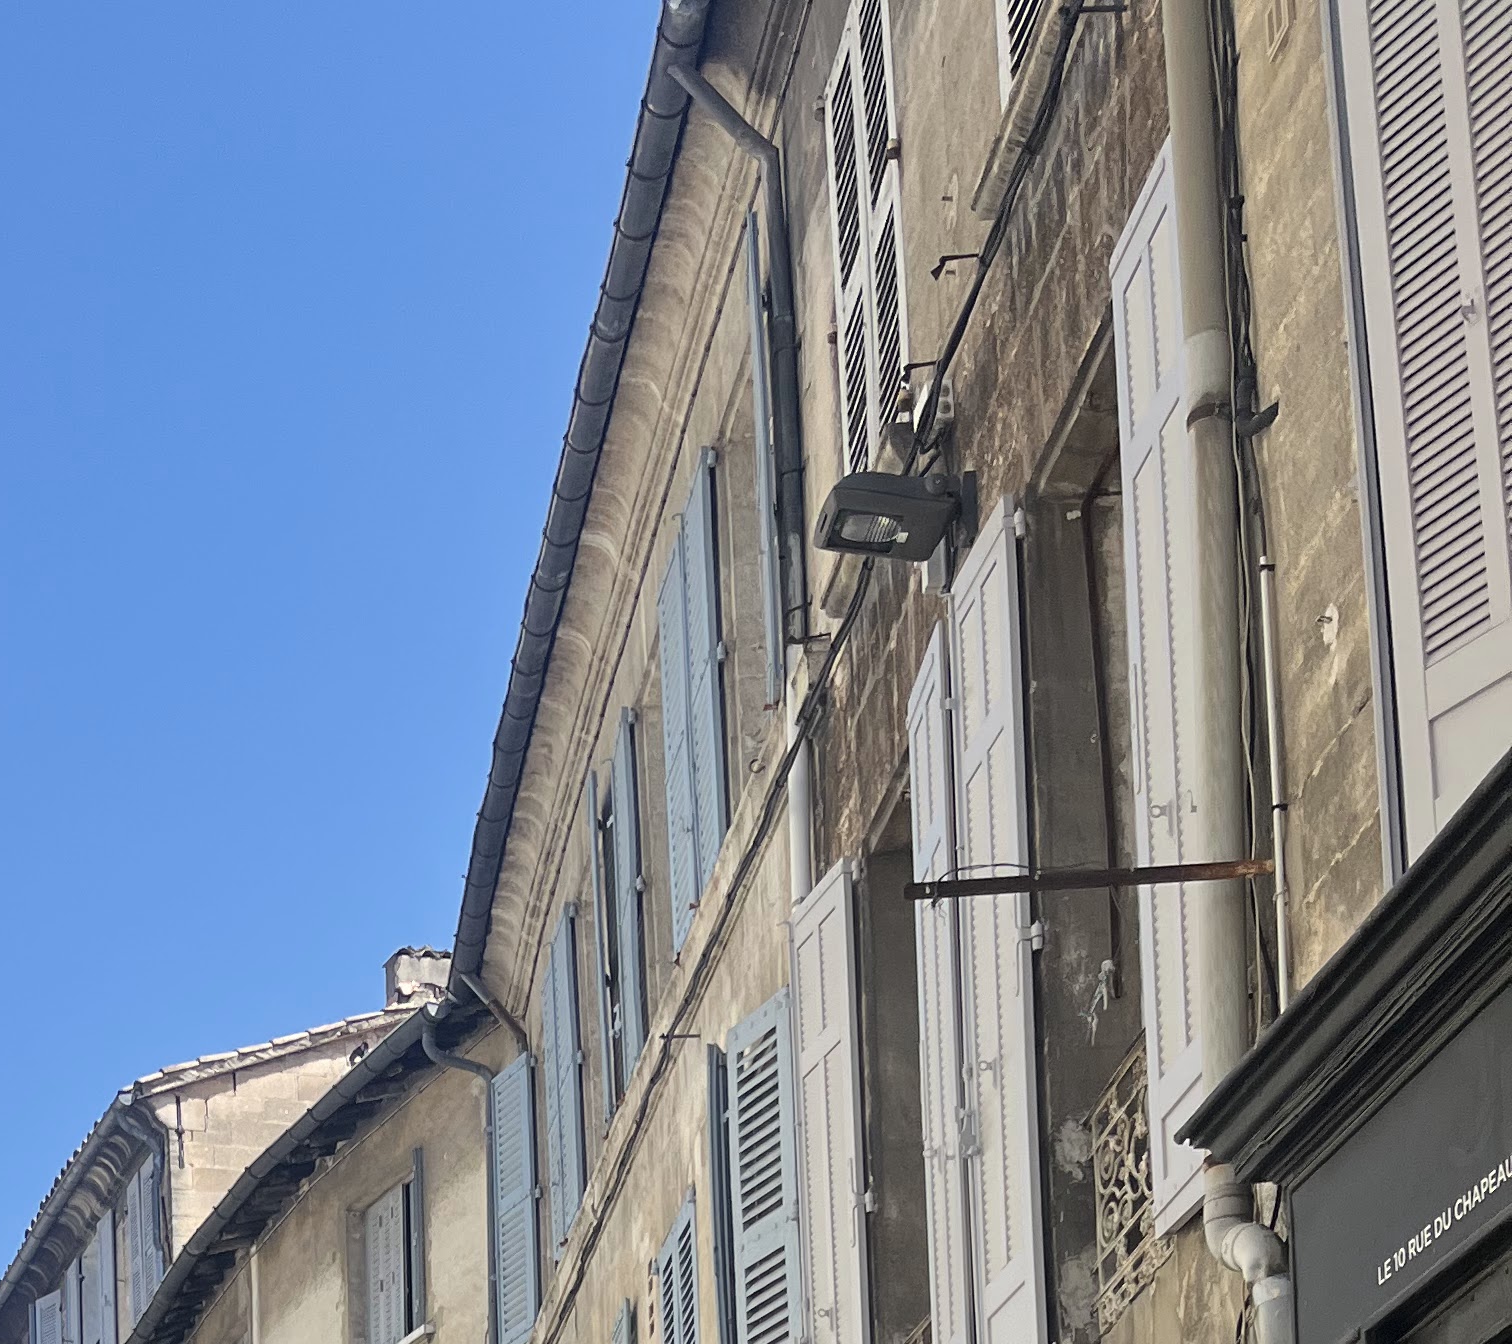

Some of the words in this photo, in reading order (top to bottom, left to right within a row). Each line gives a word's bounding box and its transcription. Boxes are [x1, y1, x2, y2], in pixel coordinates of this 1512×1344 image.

[1377, 1258, 1392, 1286] LE
[1393, 1247, 1406, 1272] 10
[1408, 1224, 1432, 1260] RUE
[1434, 1207, 1452, 1239] DU
